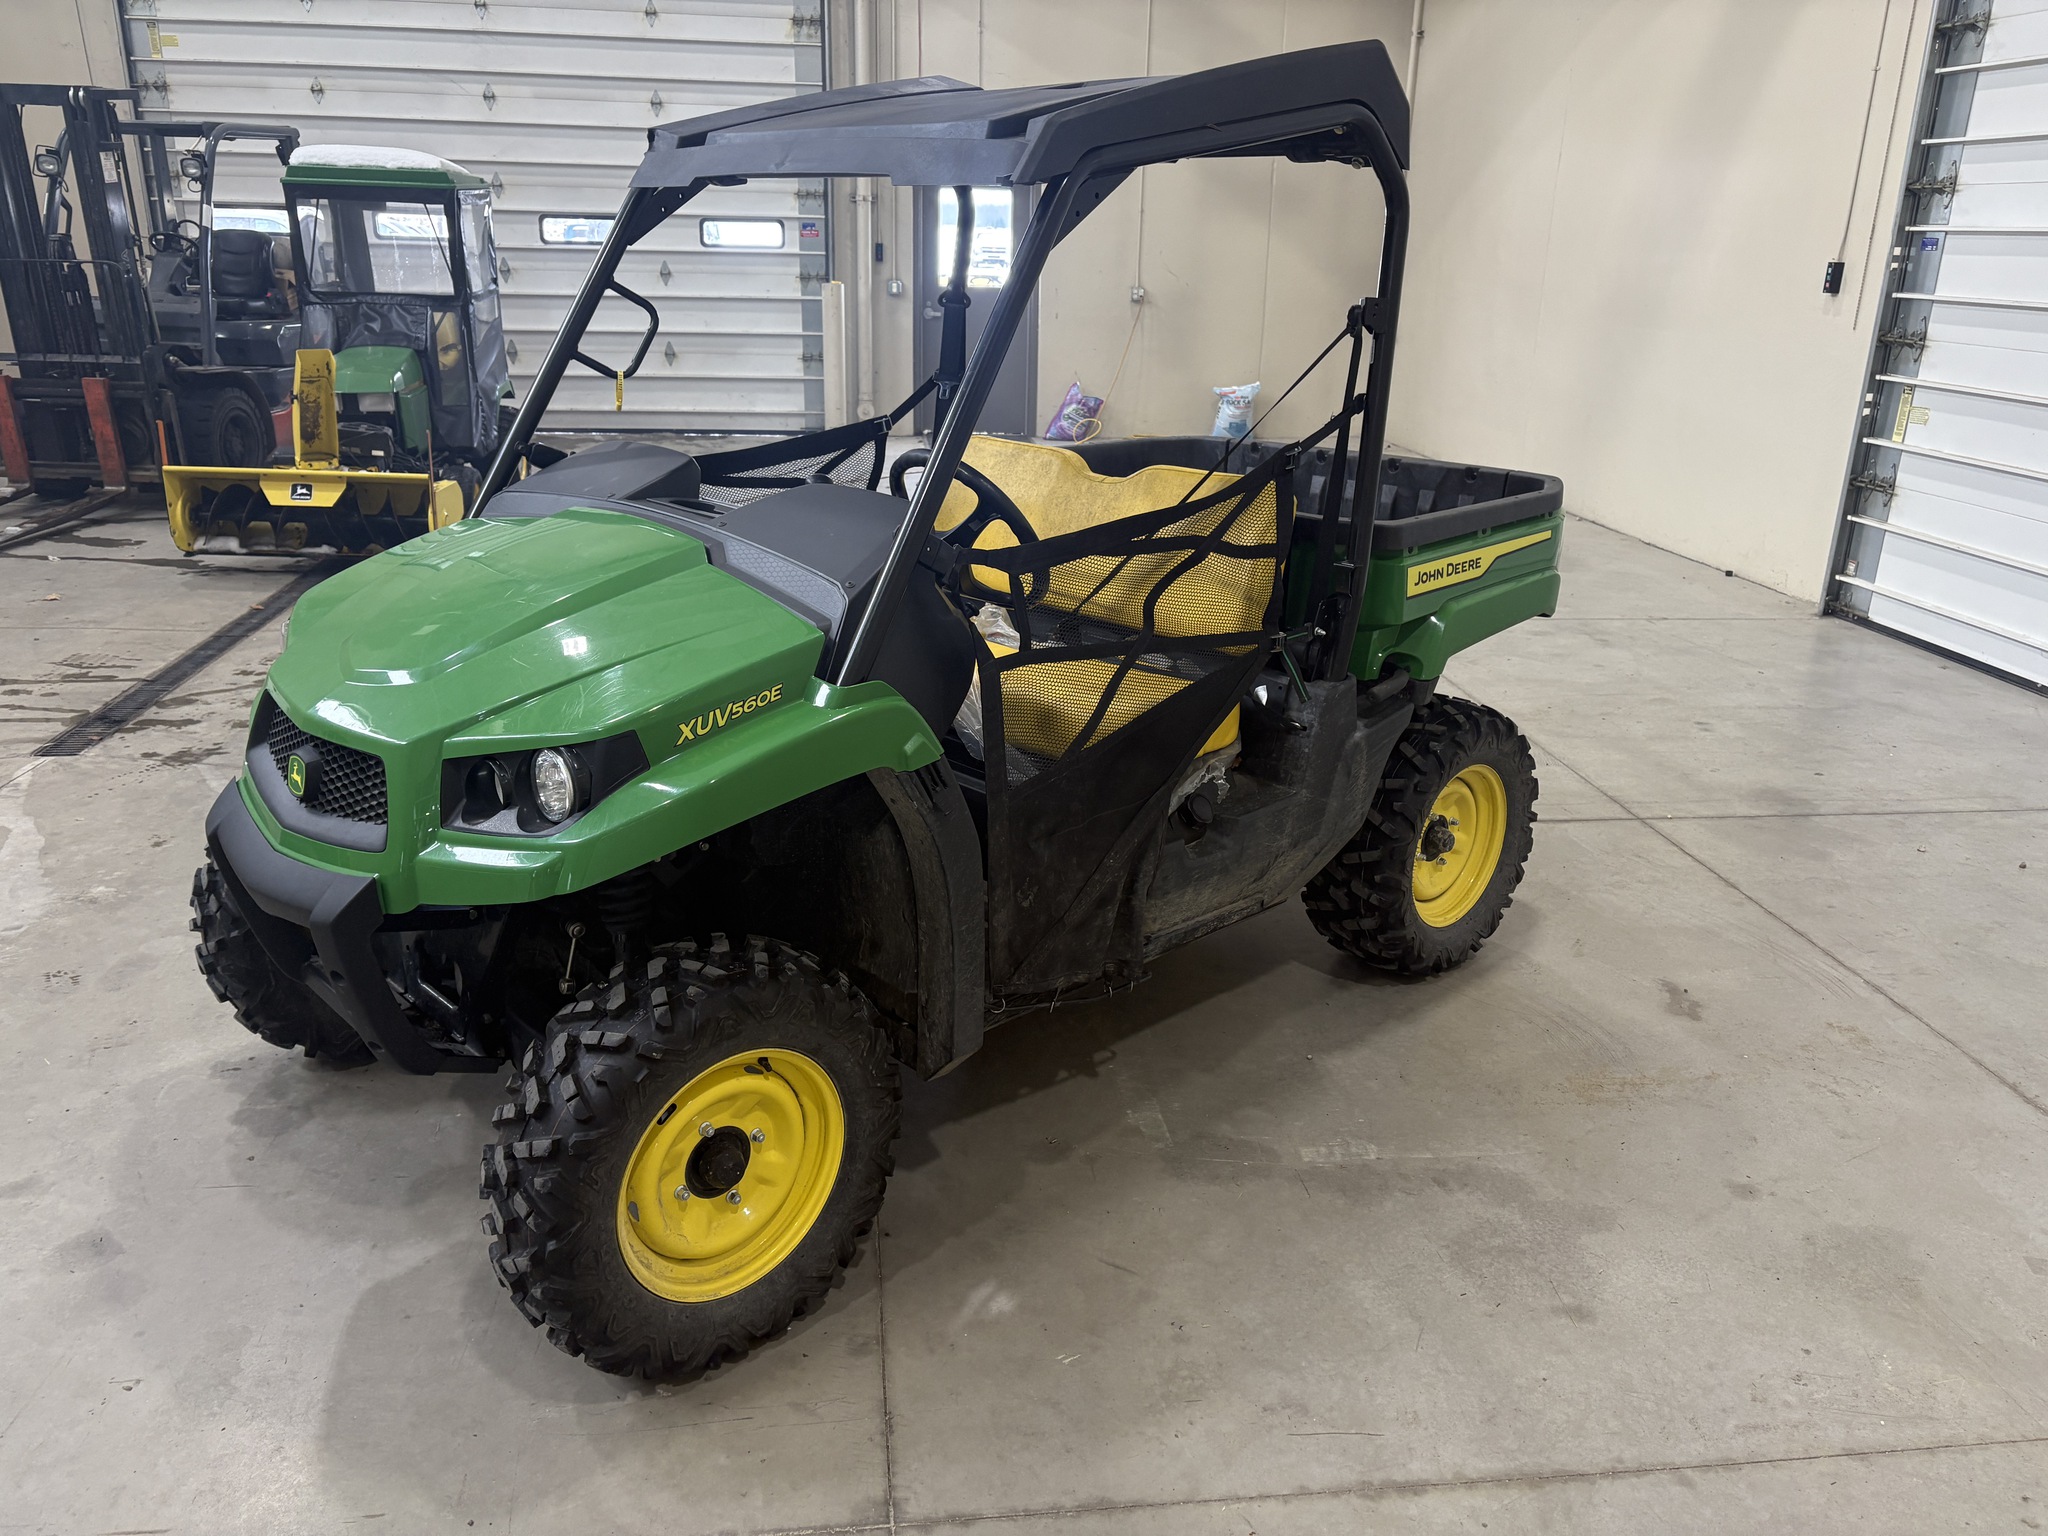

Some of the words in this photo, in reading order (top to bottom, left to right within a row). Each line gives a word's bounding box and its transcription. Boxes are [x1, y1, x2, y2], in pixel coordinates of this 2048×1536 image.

[1414, 566, 1444, 587] JOHN
[1446, 557, 1482, 577] DEERE
[674, 683, 783, 748] XUV560E
